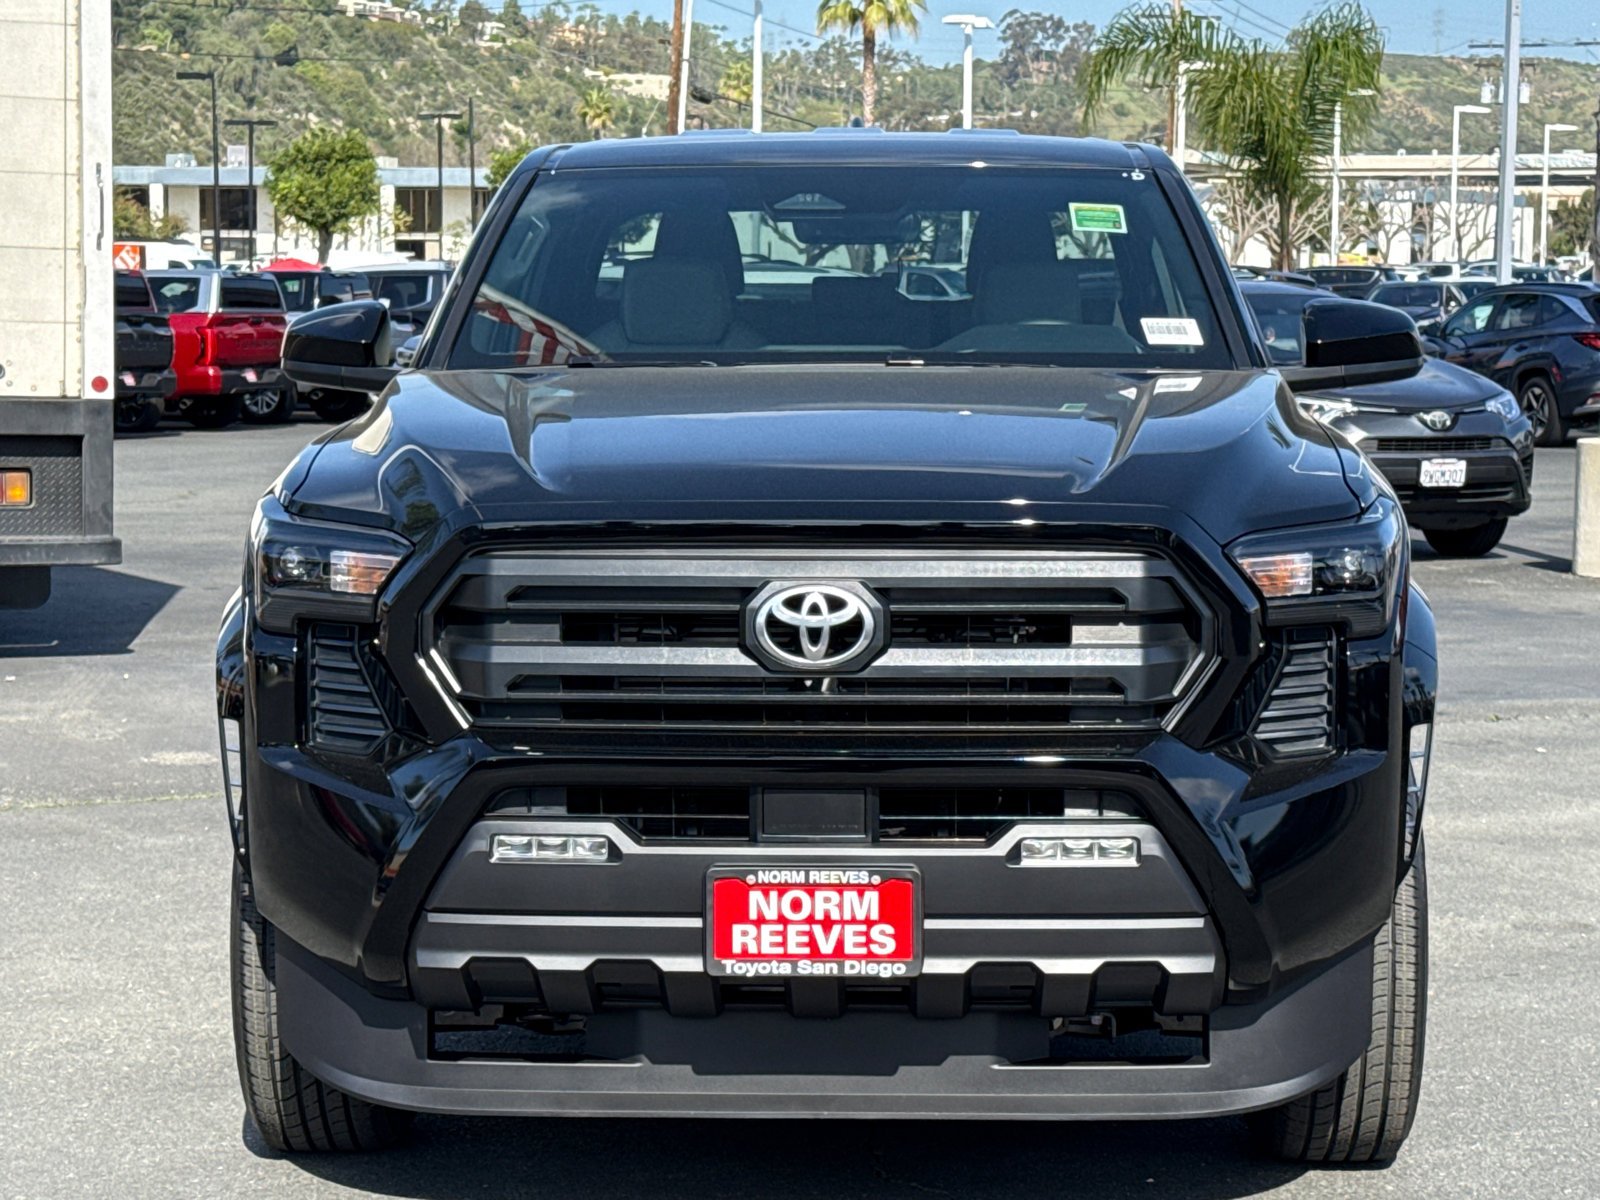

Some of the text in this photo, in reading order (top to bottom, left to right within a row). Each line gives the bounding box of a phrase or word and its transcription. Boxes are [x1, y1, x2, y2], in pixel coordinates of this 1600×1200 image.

[757, 870, 869, 884] NORM REEVES
[748, 890, 880, 921] NORM
[731, 924, 897, 955] REEVES
[721, 960, 906, 978] Toyota San Diego
